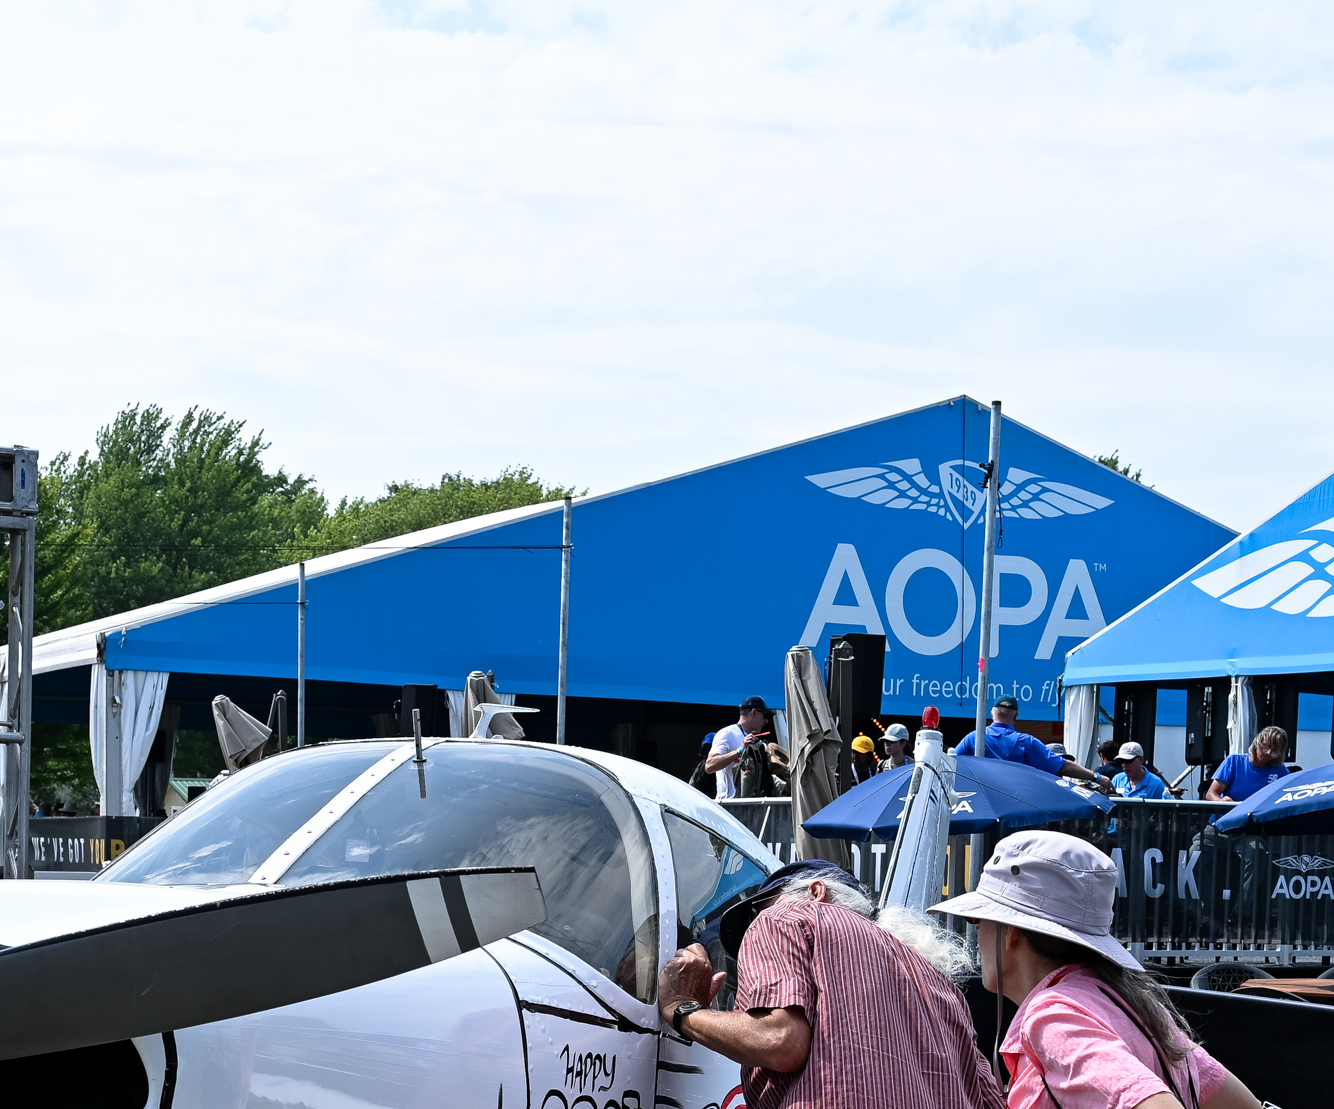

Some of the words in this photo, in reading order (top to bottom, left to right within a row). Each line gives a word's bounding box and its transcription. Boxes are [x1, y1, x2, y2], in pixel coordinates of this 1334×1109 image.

[948, 472, 977, 507] 1939
[799, 543, 1107, 660] AOPA
[1013, 680, 1033, 701] to
[67, 838, 85, 864] GOT
[559, 1044, 617, 1094] HAPPY
